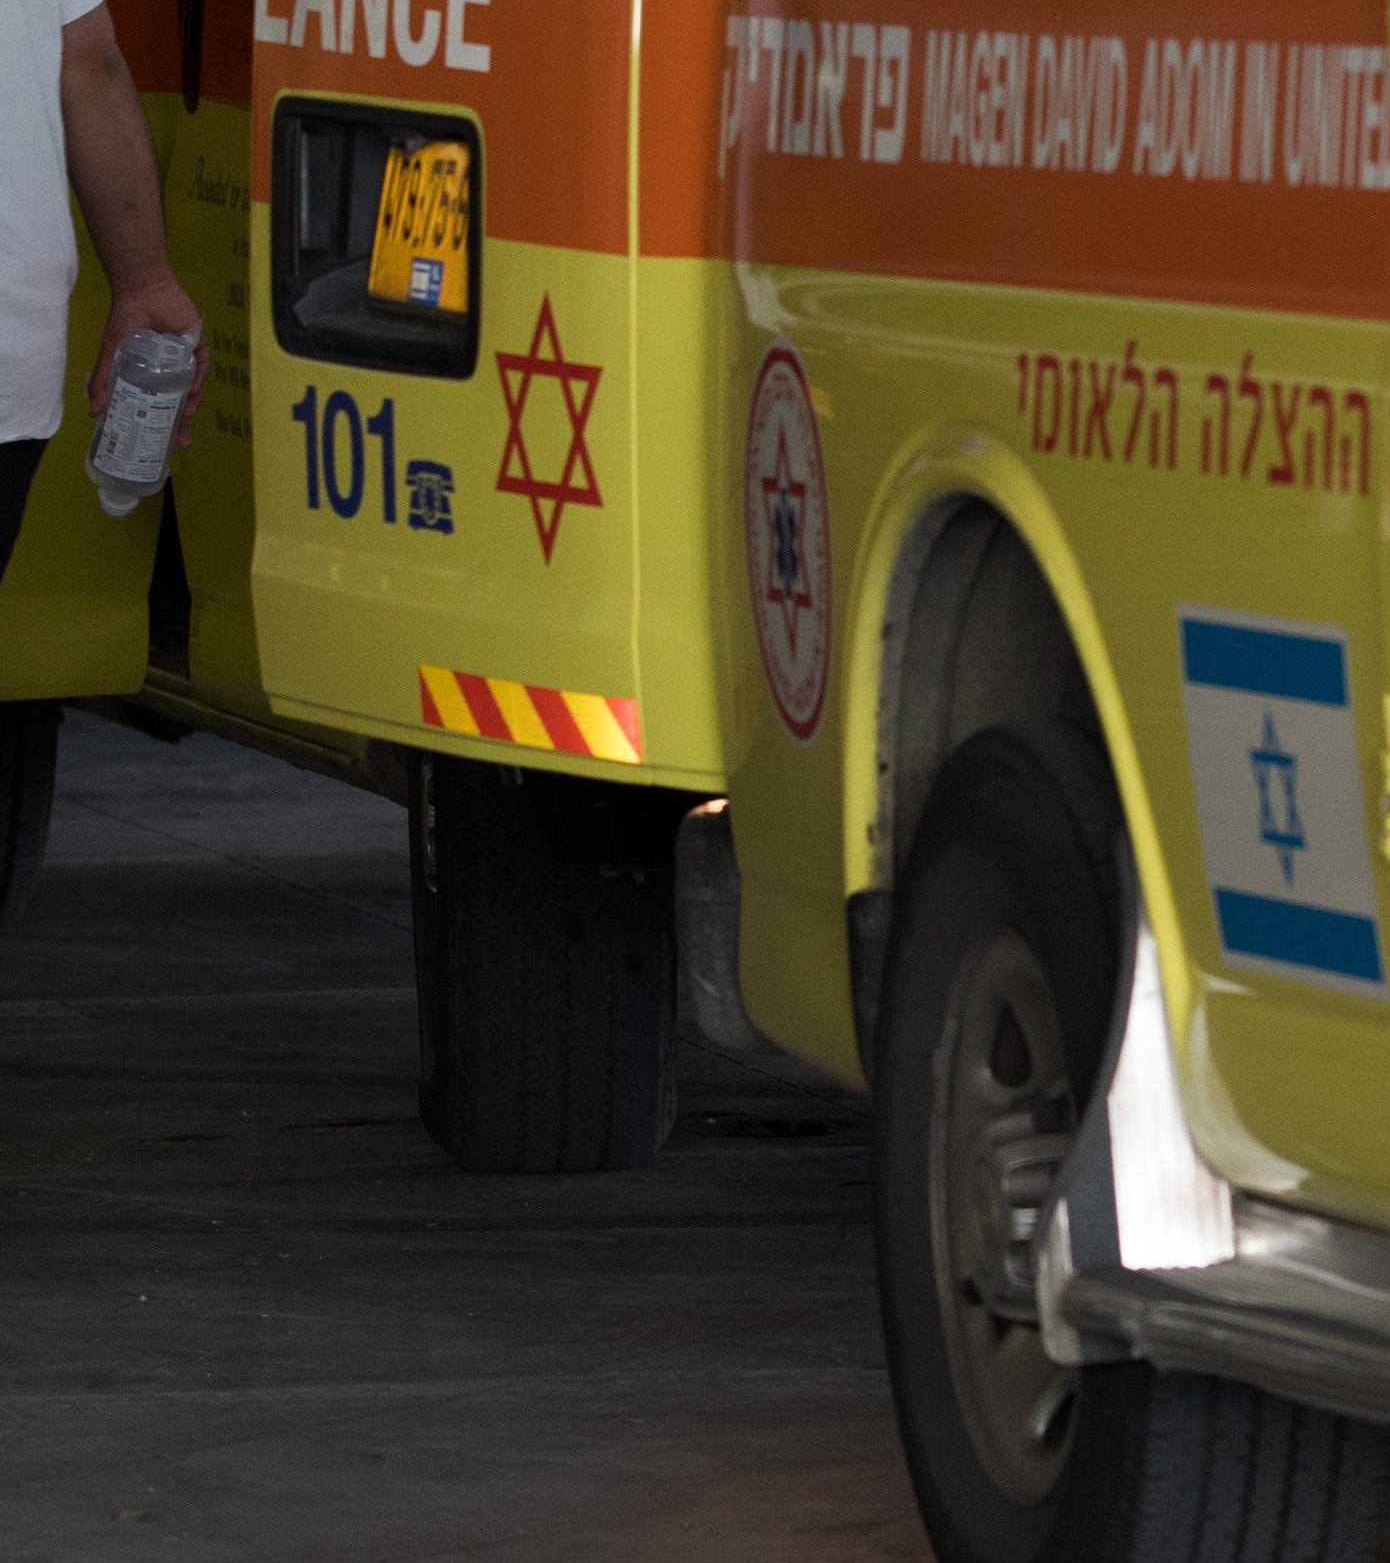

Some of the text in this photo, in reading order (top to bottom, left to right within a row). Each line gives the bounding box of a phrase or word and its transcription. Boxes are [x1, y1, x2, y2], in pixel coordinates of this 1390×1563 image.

[920, 30, 1029, 167] MAGEN
[1031, 32, 1128, 174] DAVID
[1132, 37, 1237, 181] ADOM
[1239, 41, 1280, 183] IN
[292, 384, 396, 524] 101
[1016, 339, 1180, 472] הלאומי
[1200, 352, 1372, 496] ההצלה
